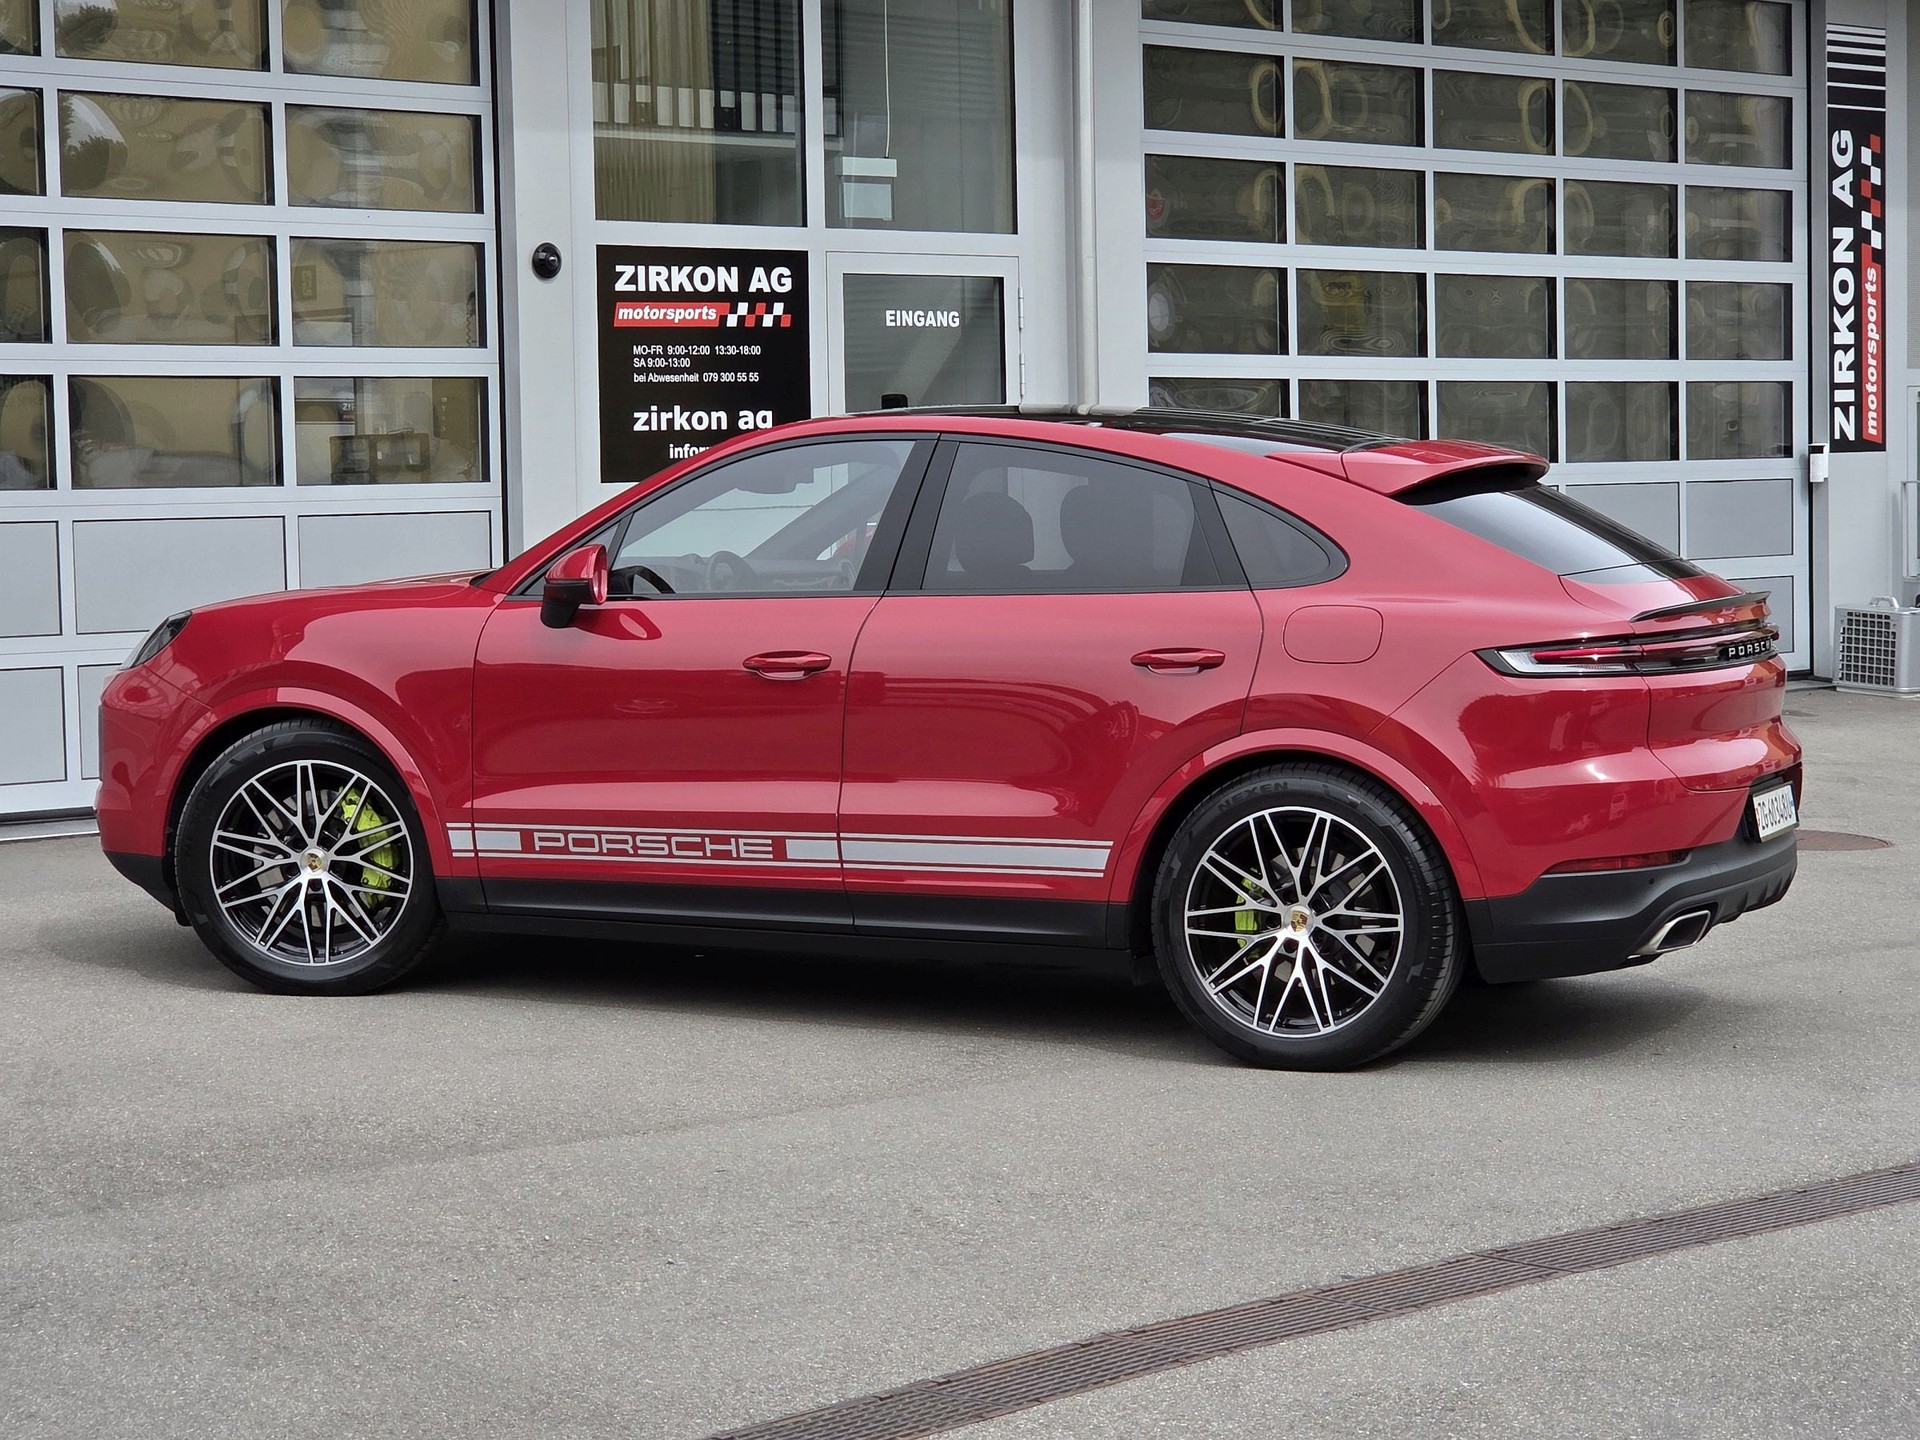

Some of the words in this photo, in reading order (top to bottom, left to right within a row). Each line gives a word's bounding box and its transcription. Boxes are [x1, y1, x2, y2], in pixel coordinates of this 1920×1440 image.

[1831, 129, 1855, 208] AG
[614, 264, 739, 293] ZIRKON
[748, 266, 793, 293] AG
[617, 305, 717, 324] motorsports
[885, 310, 960, 328] EINGANG
[1832, 227, 1856, 442] ZIRKON
[633, 345, 663, 355] MO-FR
[667, 345, 710, 356] 9:00-12:00
[715, 345, 761, 356] 13:30-18:00
[633, 357, 646, 368] SA
[647, 357, 691, 368] 9:00-13:00
[1866, 266, 1882, 437] motorsports
[633, 372, 646, 382] bei
[647, 372, 700, 383] Abwesenheit
[703, 372, 718, 382] 079
[720, 372, 735, 382] 300
[736, 372, 747, 382] 55
[749, 372, 759, 382] 55
[633, 405, 728, 431] zirkon
[1217, 781, 1289, 813] NEXEN
[533, 831, 774, 860] PORSCHE
